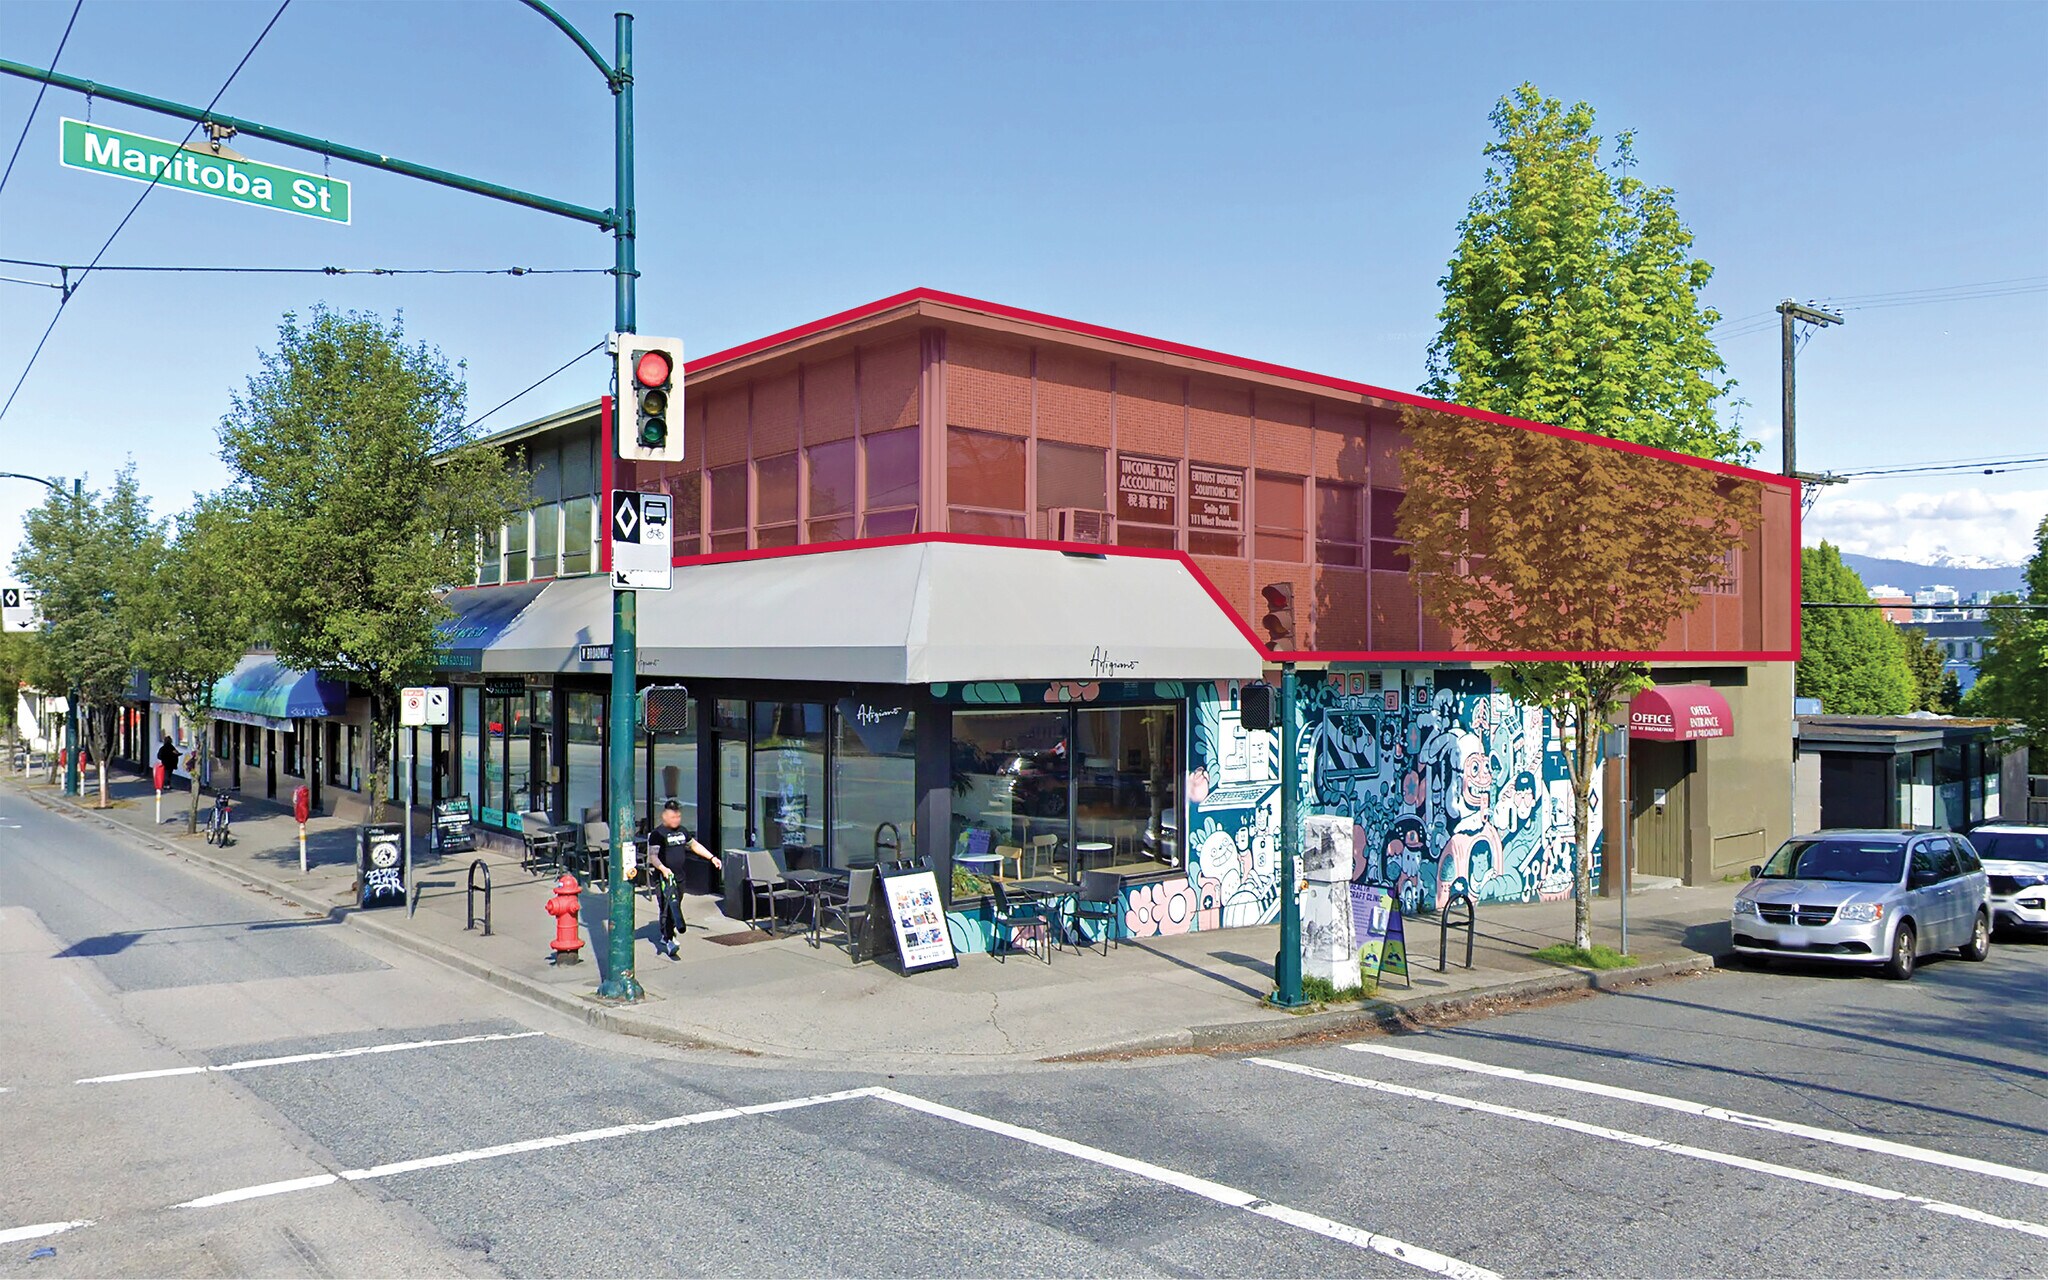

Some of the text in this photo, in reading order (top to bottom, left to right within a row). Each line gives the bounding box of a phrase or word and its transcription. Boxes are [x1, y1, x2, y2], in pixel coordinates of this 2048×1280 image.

[84, 131, 331, 213] Manitoba St
[1121, 461, 1174, 479] INCOME TAX
[1120, 475, 1175, 493] ACCOUNTING
[1191, 471, 1243, 486] ENTRUST BUSINESS
[1195, 484, 1239, 498] SOLUTIONS INC.
[1203, 503, 1230, 516] Suite 201
[1190, 513, 1200, 525] 111
[1201, 515, 1215, 526] West
[586, 646, 609, 659] BROADWAY
[1690, 705, 1712, 716] OFFICE
[1632, 712, 1672, 724] OFFICE
[1690, 716, 1719, 728] ENTRANCE
